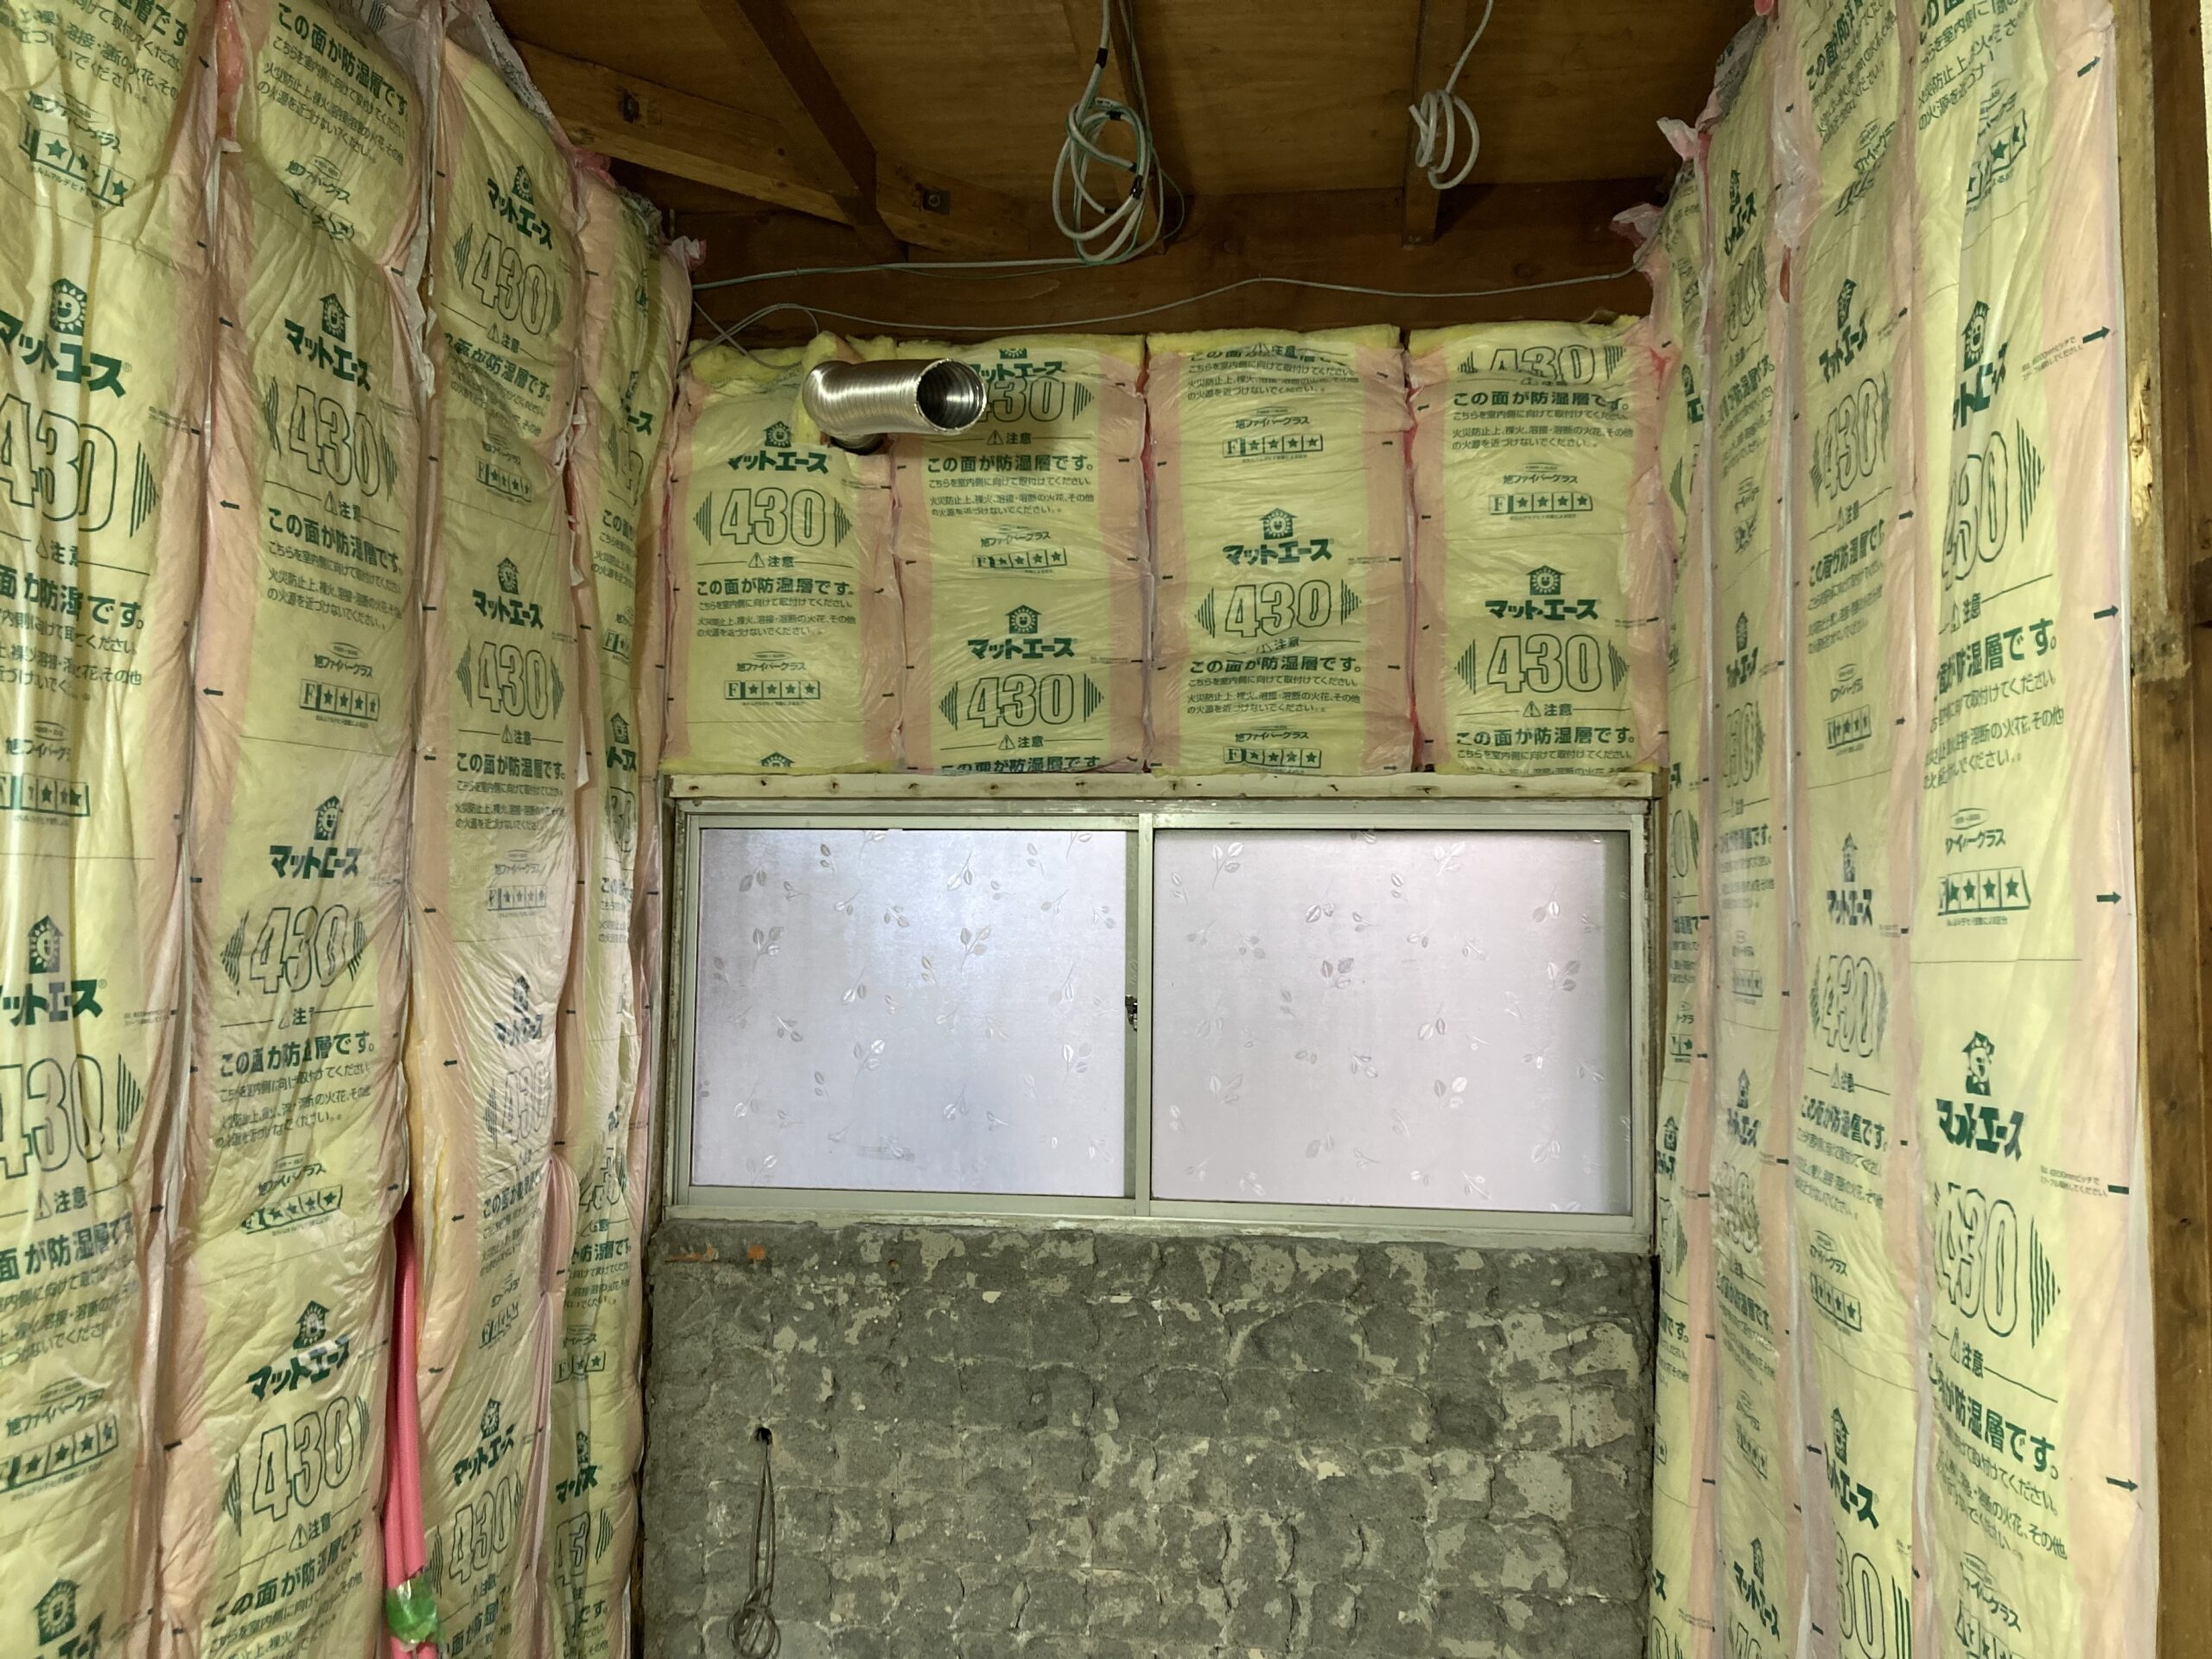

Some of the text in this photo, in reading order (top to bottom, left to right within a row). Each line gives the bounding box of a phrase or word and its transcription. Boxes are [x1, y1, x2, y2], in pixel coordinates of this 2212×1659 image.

[486, 177, 552, 251] マットエース
[472, 232, 549, 336] 430
[284, 318, 372, 391] マットエース
[976, 375, 1065, 423] 30
[1453, 391, 1630, 411] この面が防湿層です。
[289, 384, 381, 498] 430
[1006, 433, 1033, 445] 注意
[0, 392, 118, 532] 430
[728, 450, 830, 474] マットエース
[926, 454, 1094, 474] この面が防湿層です。
[720, 486, 826, 547] 430
[767, 556, 795, 569] 注意
[1222, 538, 1333, 566] マットエース
[696, 577, 855, 596] この面が防湿層です。
[472, 589, 544, 631] マットエース
[1224, 579, 1332, 638] 430
[1485, 599, 1599, 620] マットエース
[967, 638, 1076, 659] マットエース
[1273, 636, 1300, 650] 注意
[478, 641, 549, 721] 430
[1189, 656, 1363, 675] この面が防湿層です。
[1486, 633, 1603, 694] 430
[967, 673, 1074, 728] 430
[1543, 702, 1573, 716] 注意
[1017, 735, 1045, 749] 注意
[1456, 726, 1635, 747] この面が防湿層です。
[270, 844, 360, 880] マットエース
[250, 904, 348, 995] 430
[0, 978, 103, 1027] ットエース
[0, 1054, 103, 1179] 430
[54, 1185, 88, 1214] 注意
[1961, 1341, 1984, 1380] 注意
[252, 1396, 354, 1522] 430
[308, 1511, 332, 1541] 注意
